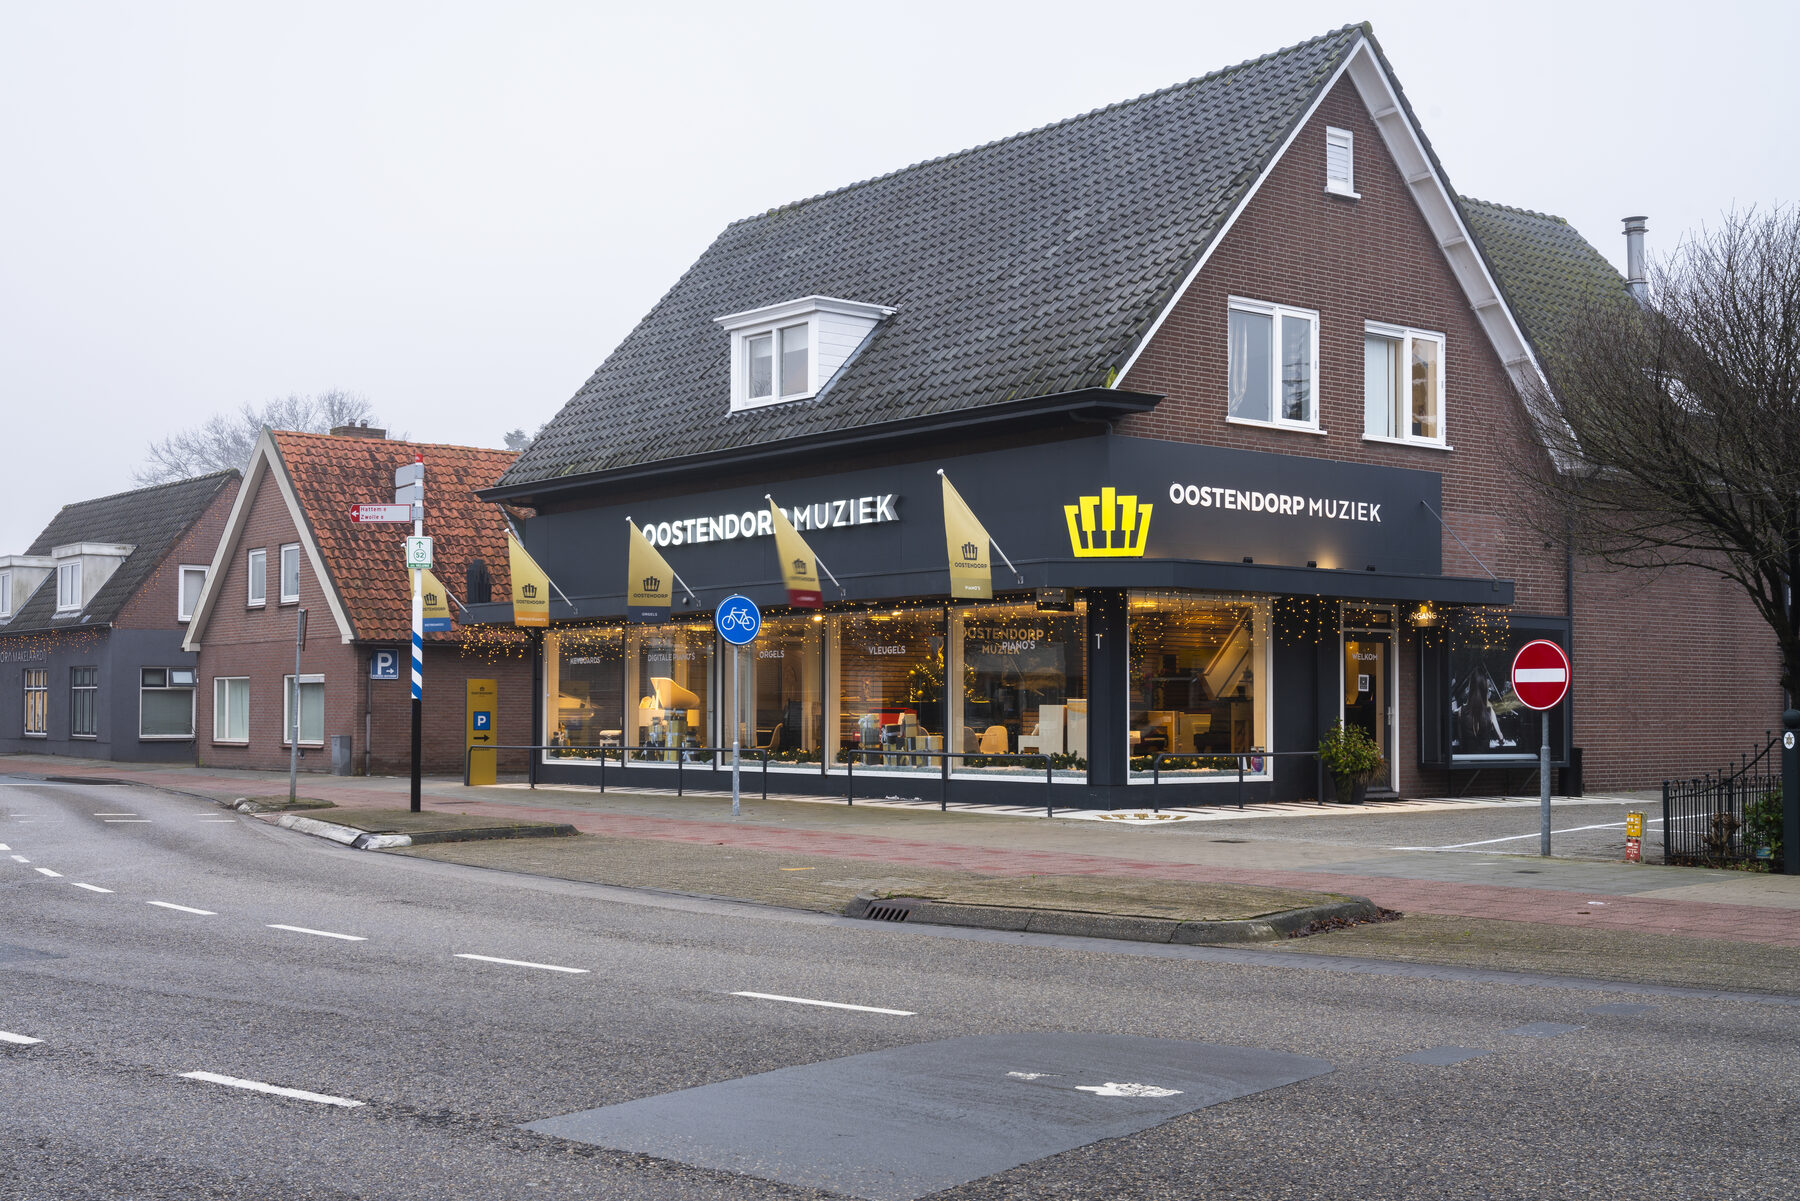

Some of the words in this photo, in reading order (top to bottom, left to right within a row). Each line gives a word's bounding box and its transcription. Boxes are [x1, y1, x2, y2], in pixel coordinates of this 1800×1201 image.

[1169, 483, 1305, 515] OOSTENDORP
[1309, 498, 1381, 522] MUZIEK
[793, 494, 896, 531] MUZIEK
[868, 645, 906, 655] VLEUGELS
[1002, 640, 1036, 651] PIANO'S
[647, 653, 673, 662] DIGITALE
[759, 650, 785, 658] ORGELS
[1352, 653, 1378, 661] WELKOM
[377, 652, 393, 675] P
[477, 715, 487, 727] P
